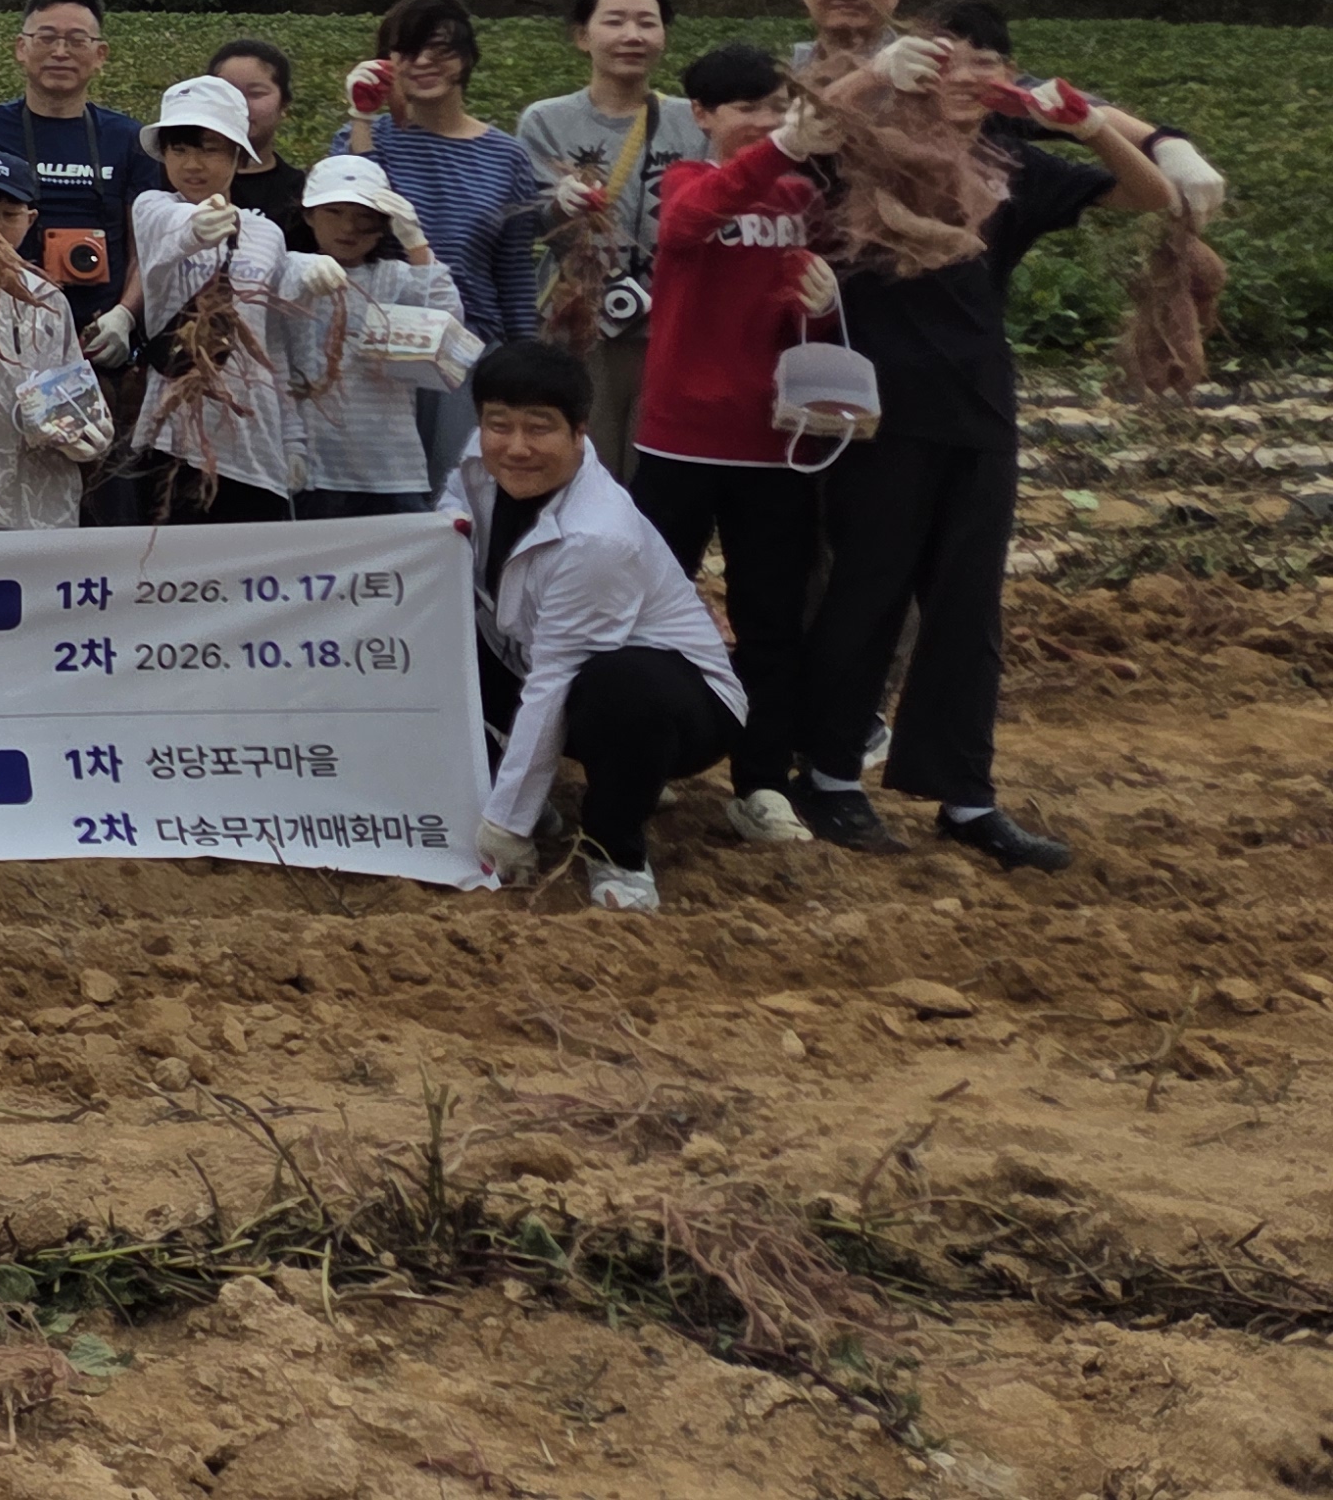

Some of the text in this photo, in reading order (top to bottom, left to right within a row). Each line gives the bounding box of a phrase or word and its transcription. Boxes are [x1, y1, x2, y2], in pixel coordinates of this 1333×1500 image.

[56, 576, 113, 610] 1차
[134, 579, 229, 604] 2026.
[239, 575, 290, 602] 10.
[298, 570, 404, 607] 17.(토)
[54, 636, 411, 675] 2차 2026. 10. 18.(일)
[64, 743, 124, 783] 1차
[145, 743, 339, 780] 성당포구마을
[73, 811, 450, 849] 2차 다송무지개매화마을
